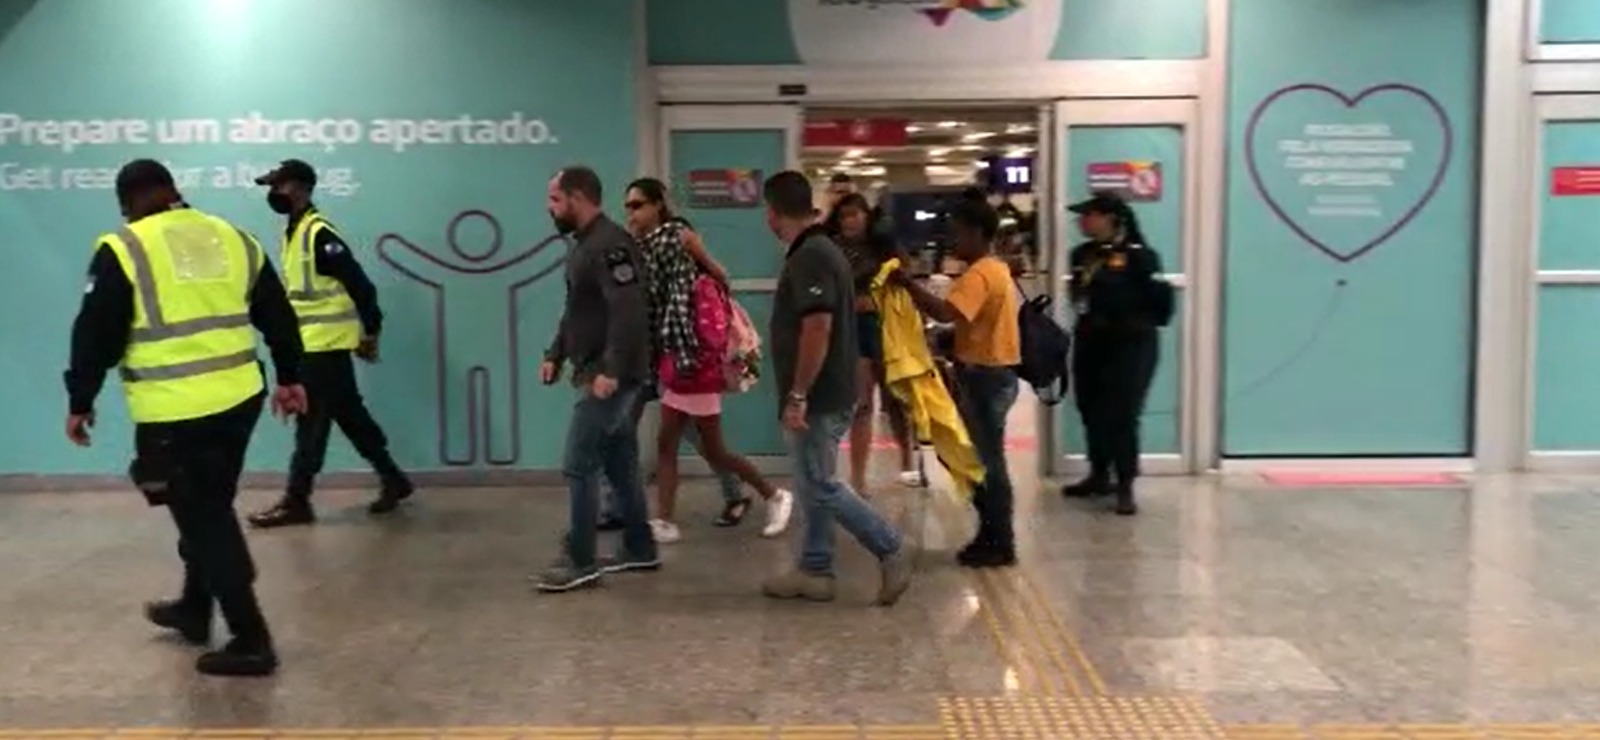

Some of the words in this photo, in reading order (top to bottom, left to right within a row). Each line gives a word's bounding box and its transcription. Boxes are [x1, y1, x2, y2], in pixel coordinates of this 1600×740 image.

[0, 113, 149, 152] Prepare
[156, 118, 219, 143] um
[228, 111, 360, 152] abraço
[369, 112, 559, 152] apertado.
[0, 162, 54, 190] Get
[212, 165, 232, 189] a
[1005, 166, 1029, 183] 11
